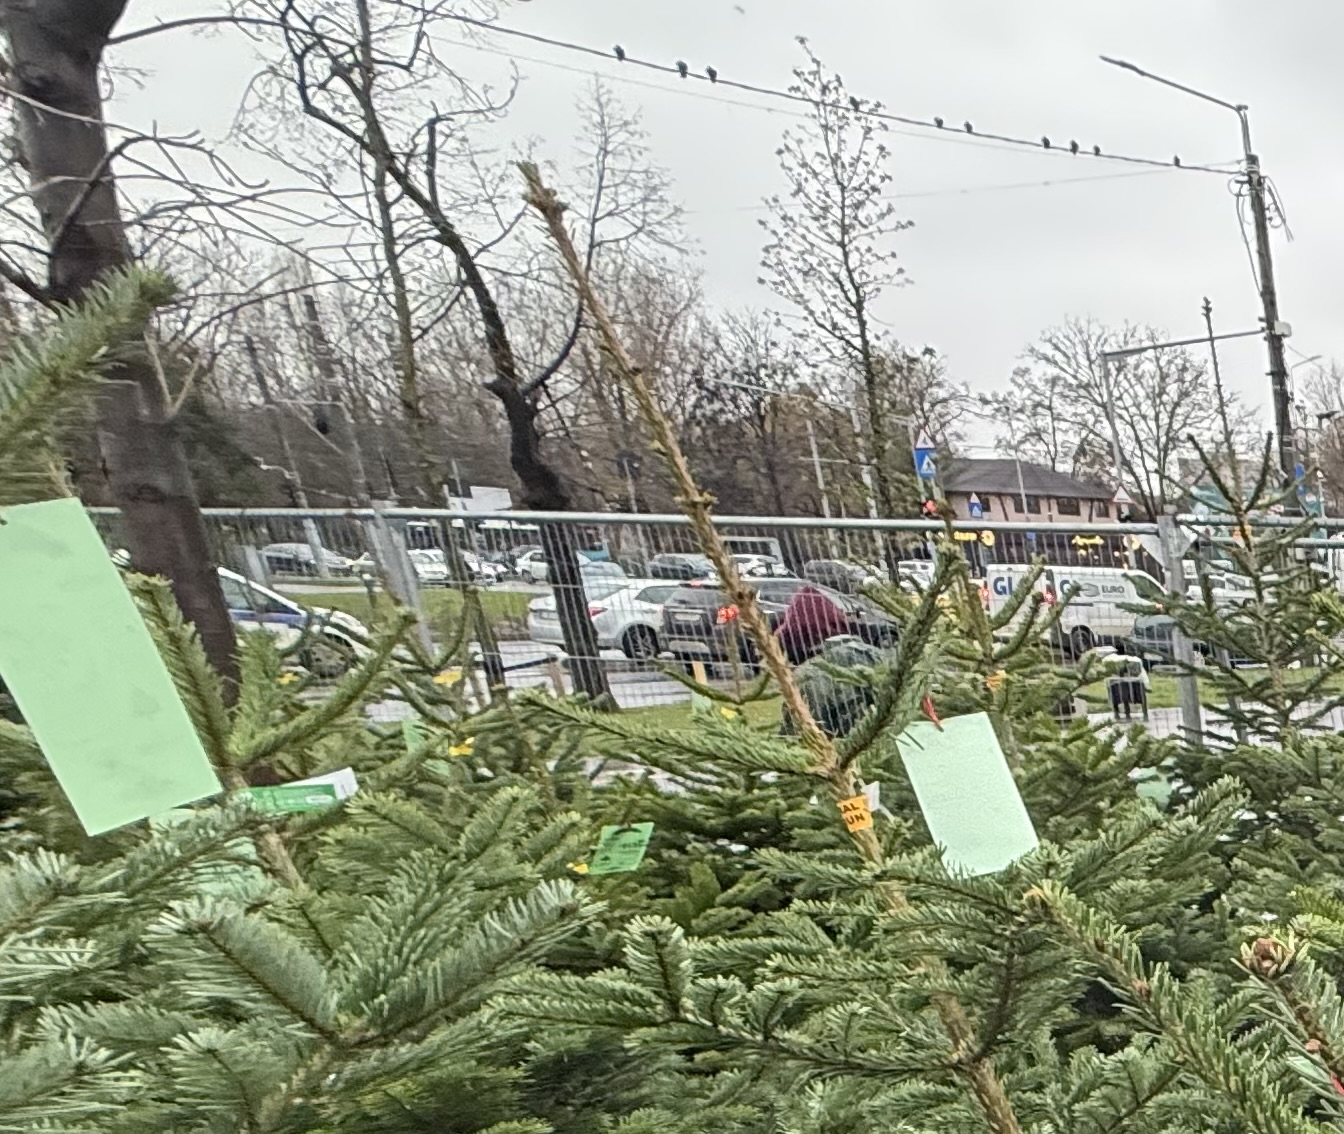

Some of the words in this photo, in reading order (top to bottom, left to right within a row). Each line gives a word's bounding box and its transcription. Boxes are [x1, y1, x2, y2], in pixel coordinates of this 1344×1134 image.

[1102, 585, 1125, 594] EURO
[842, 802, 861, 814] AL
[846, 813, 865, 825] UN
